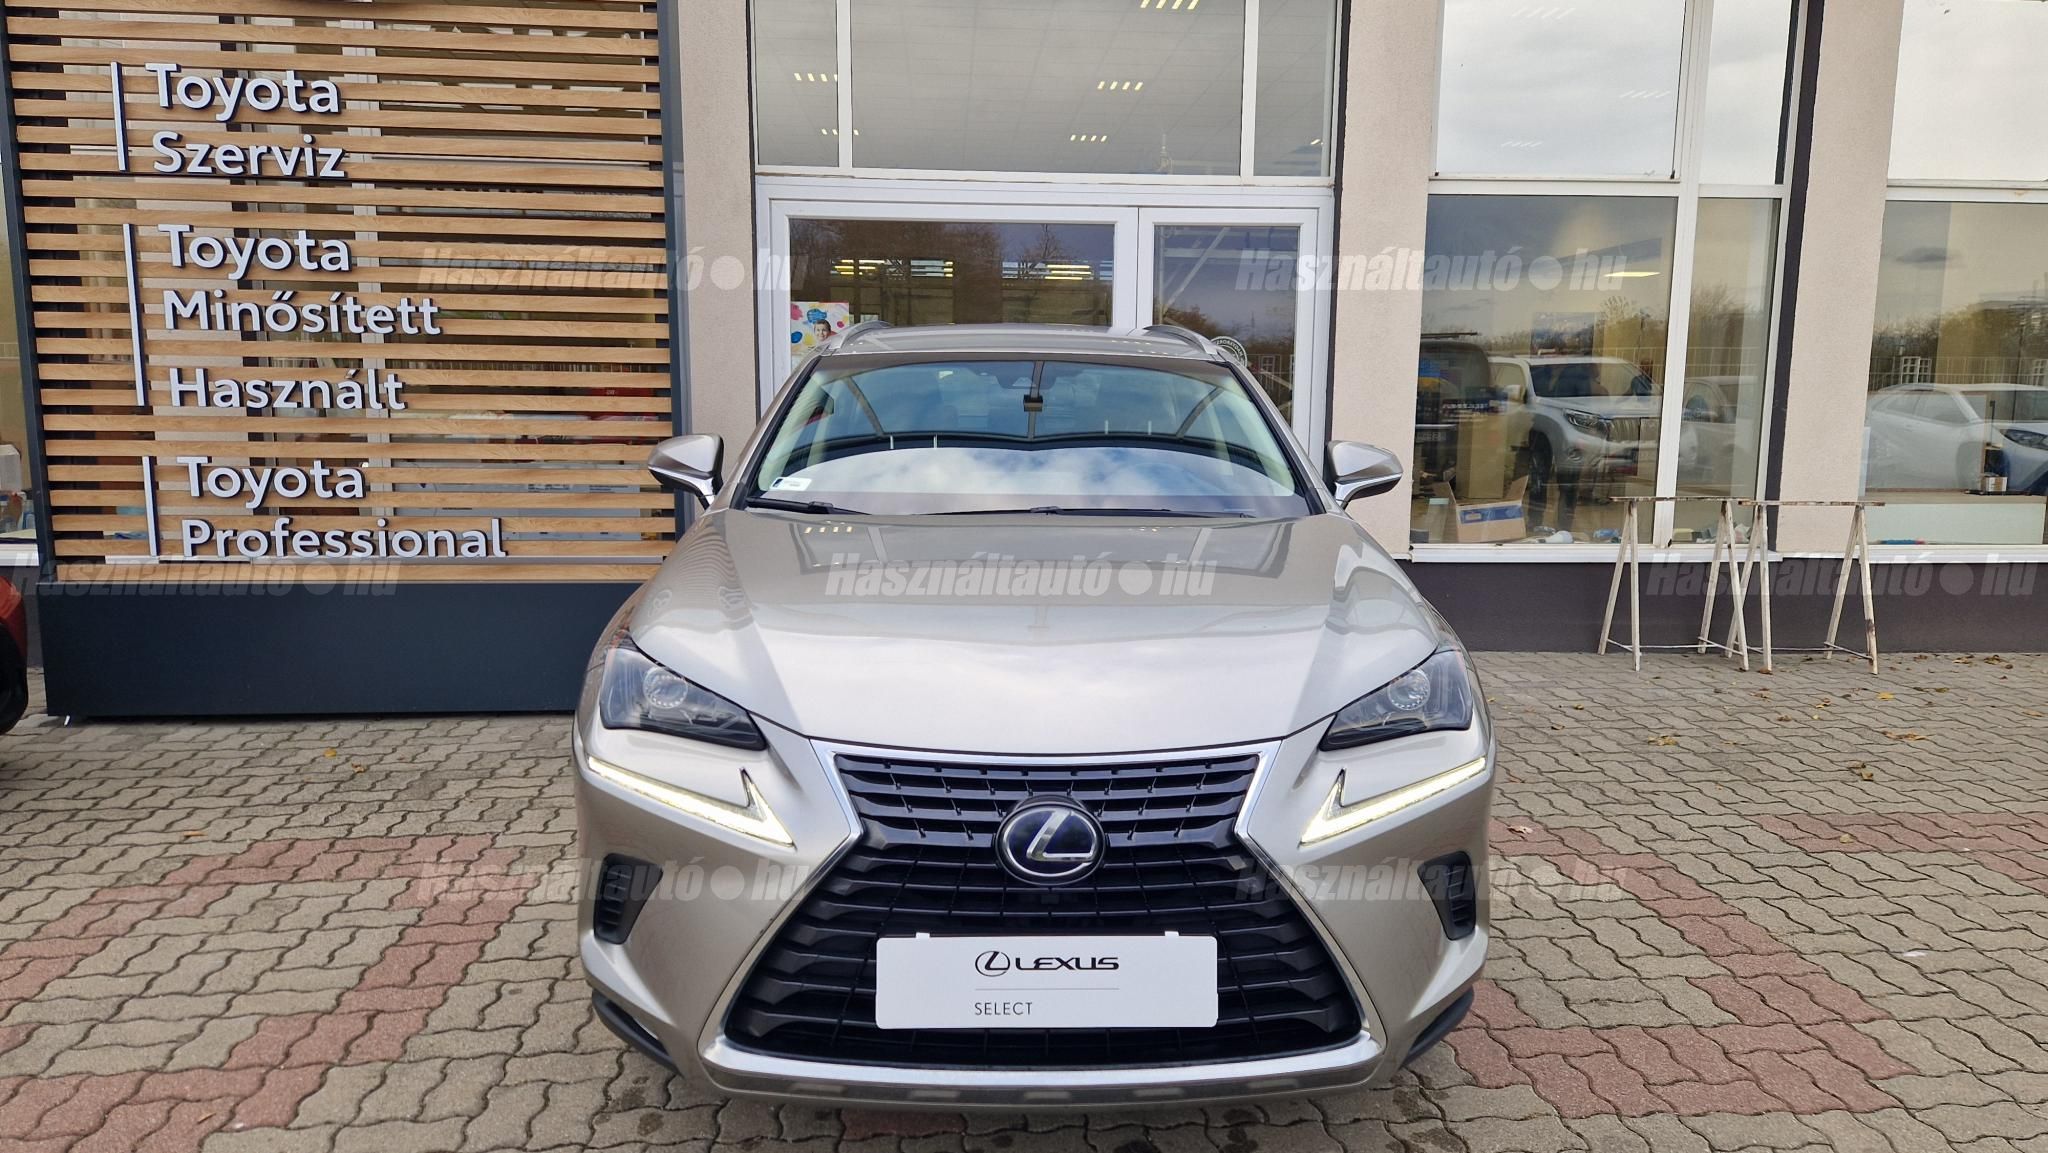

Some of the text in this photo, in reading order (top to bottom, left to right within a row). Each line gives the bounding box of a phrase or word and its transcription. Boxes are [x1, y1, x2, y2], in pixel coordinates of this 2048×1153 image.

[145, 63, 341, 122] Toyota
[153, 131, 346, 177] Szerviz
[158, 224, 350, 279] Toyota
[163, 290, 441, 335] Minősített
[169, 368, 406, 410] Használt
[176, 456, 365, 509] Toyota
[181, 516, 508, 558] Professional
[1014, 956, 1120, 971] LEXUS
[974, 1001, 1033, 1017] SELECT
